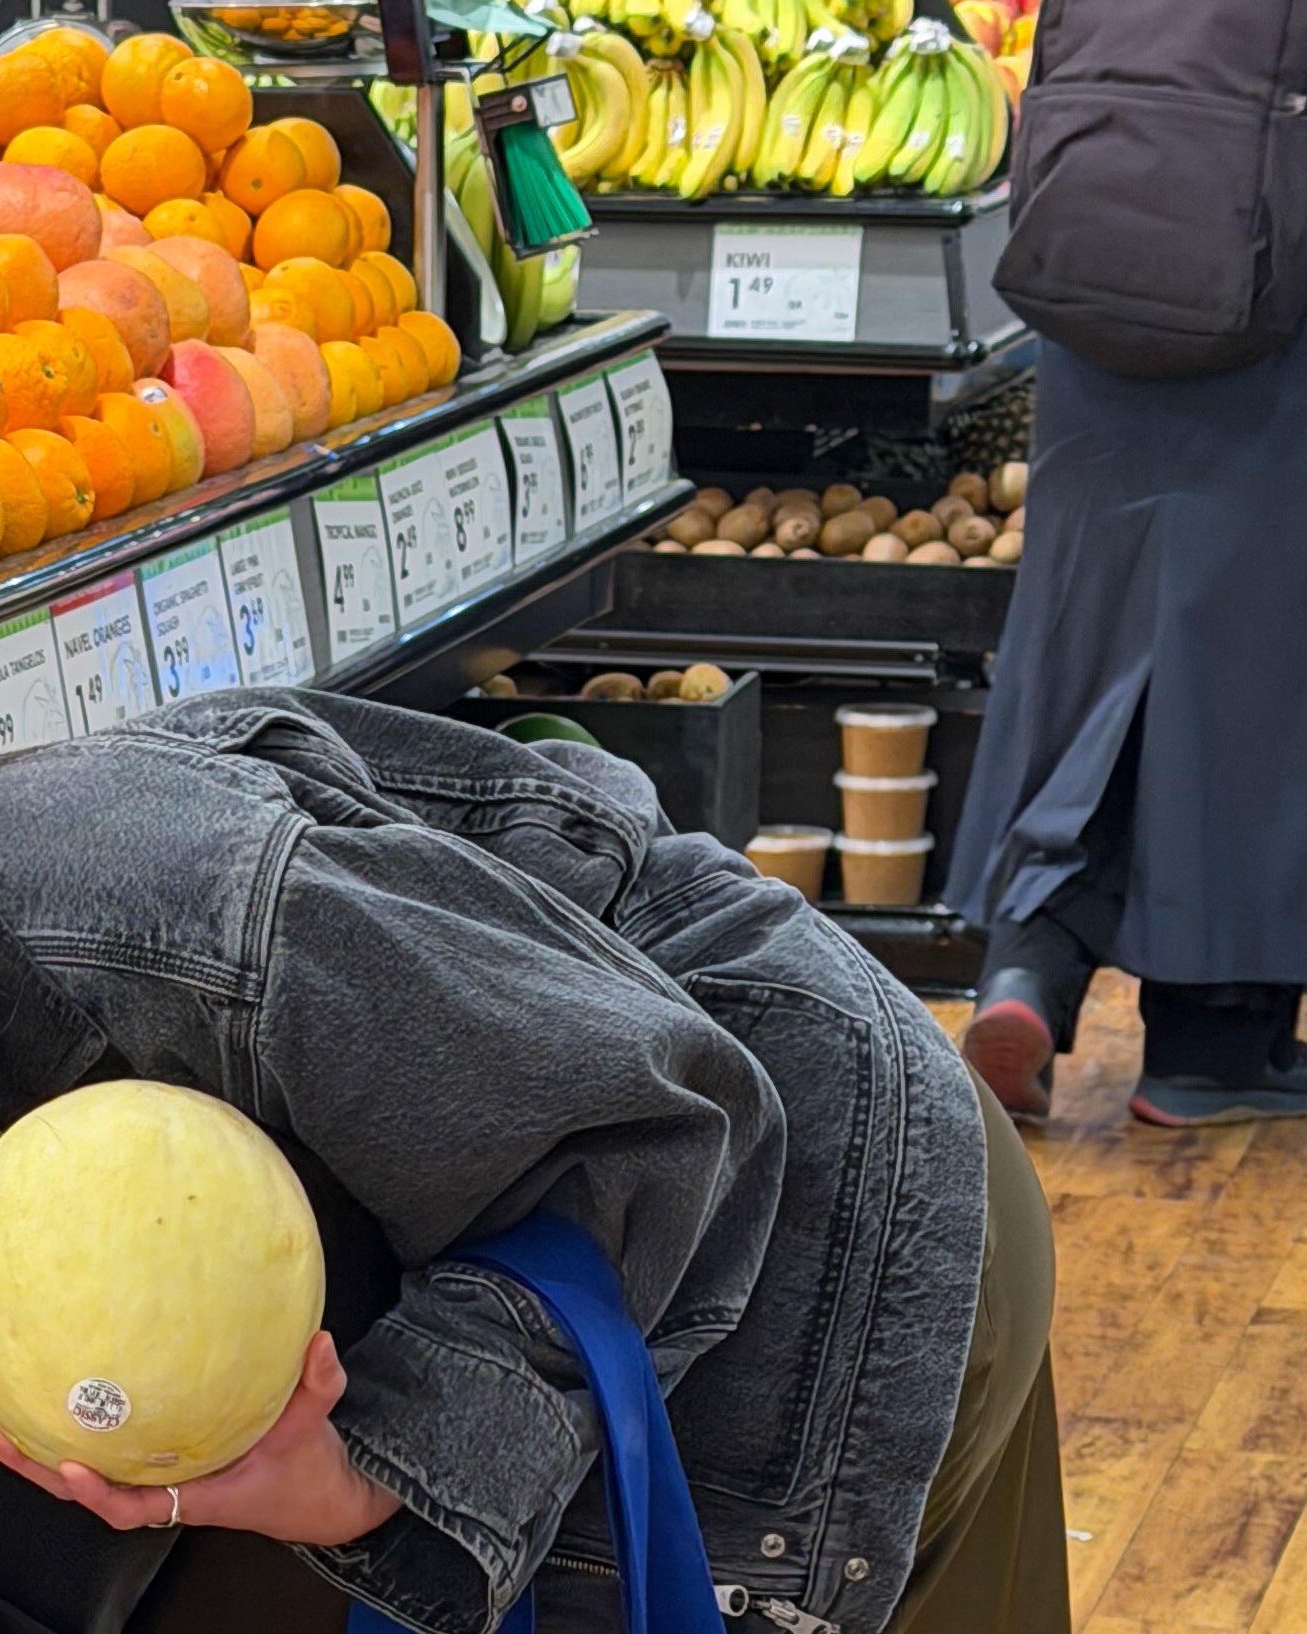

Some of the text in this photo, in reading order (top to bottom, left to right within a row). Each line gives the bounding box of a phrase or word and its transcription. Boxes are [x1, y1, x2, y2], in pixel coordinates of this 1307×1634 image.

[726, 252, 771, 269] KIWI
[63, 615, 132, 660] NAVEL ORANGES
